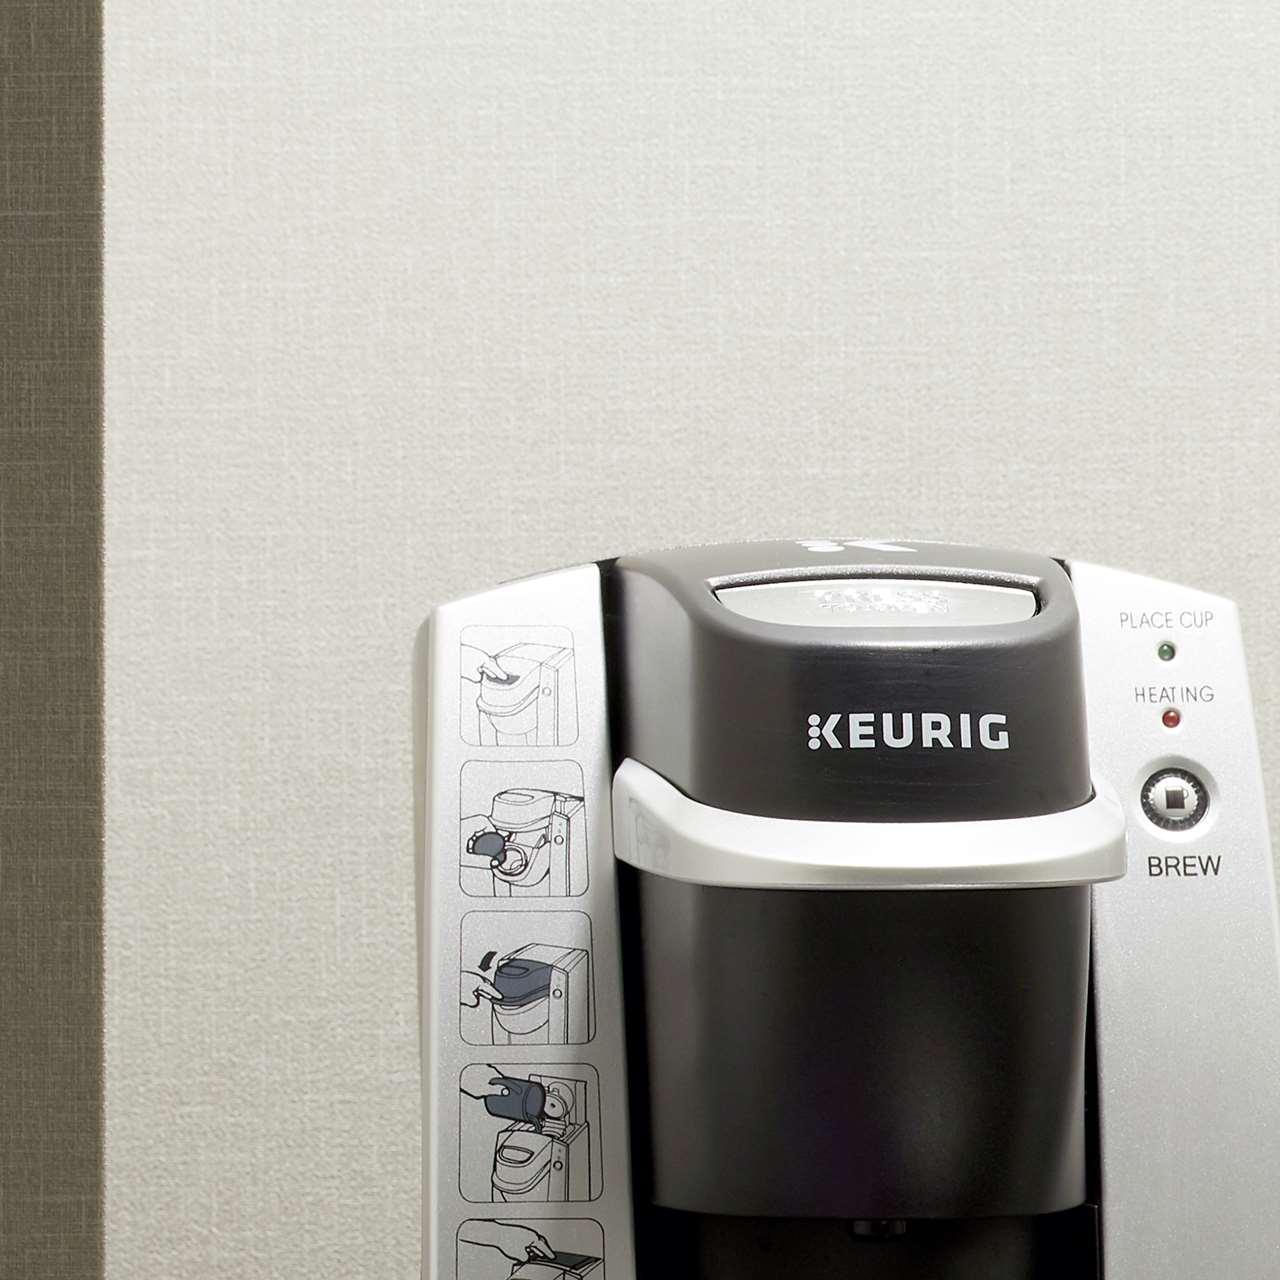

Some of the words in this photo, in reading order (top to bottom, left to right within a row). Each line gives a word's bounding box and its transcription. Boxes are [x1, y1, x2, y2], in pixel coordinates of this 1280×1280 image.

[1119, 611, 1173, 630] PLACE
[1179, 610, 1214, 629] CUP
[1134, 685, 1215, 704] HEATING
[808, 712, 1011, 750] KEURIG
[1147, 855, 1222, 877] BREW
